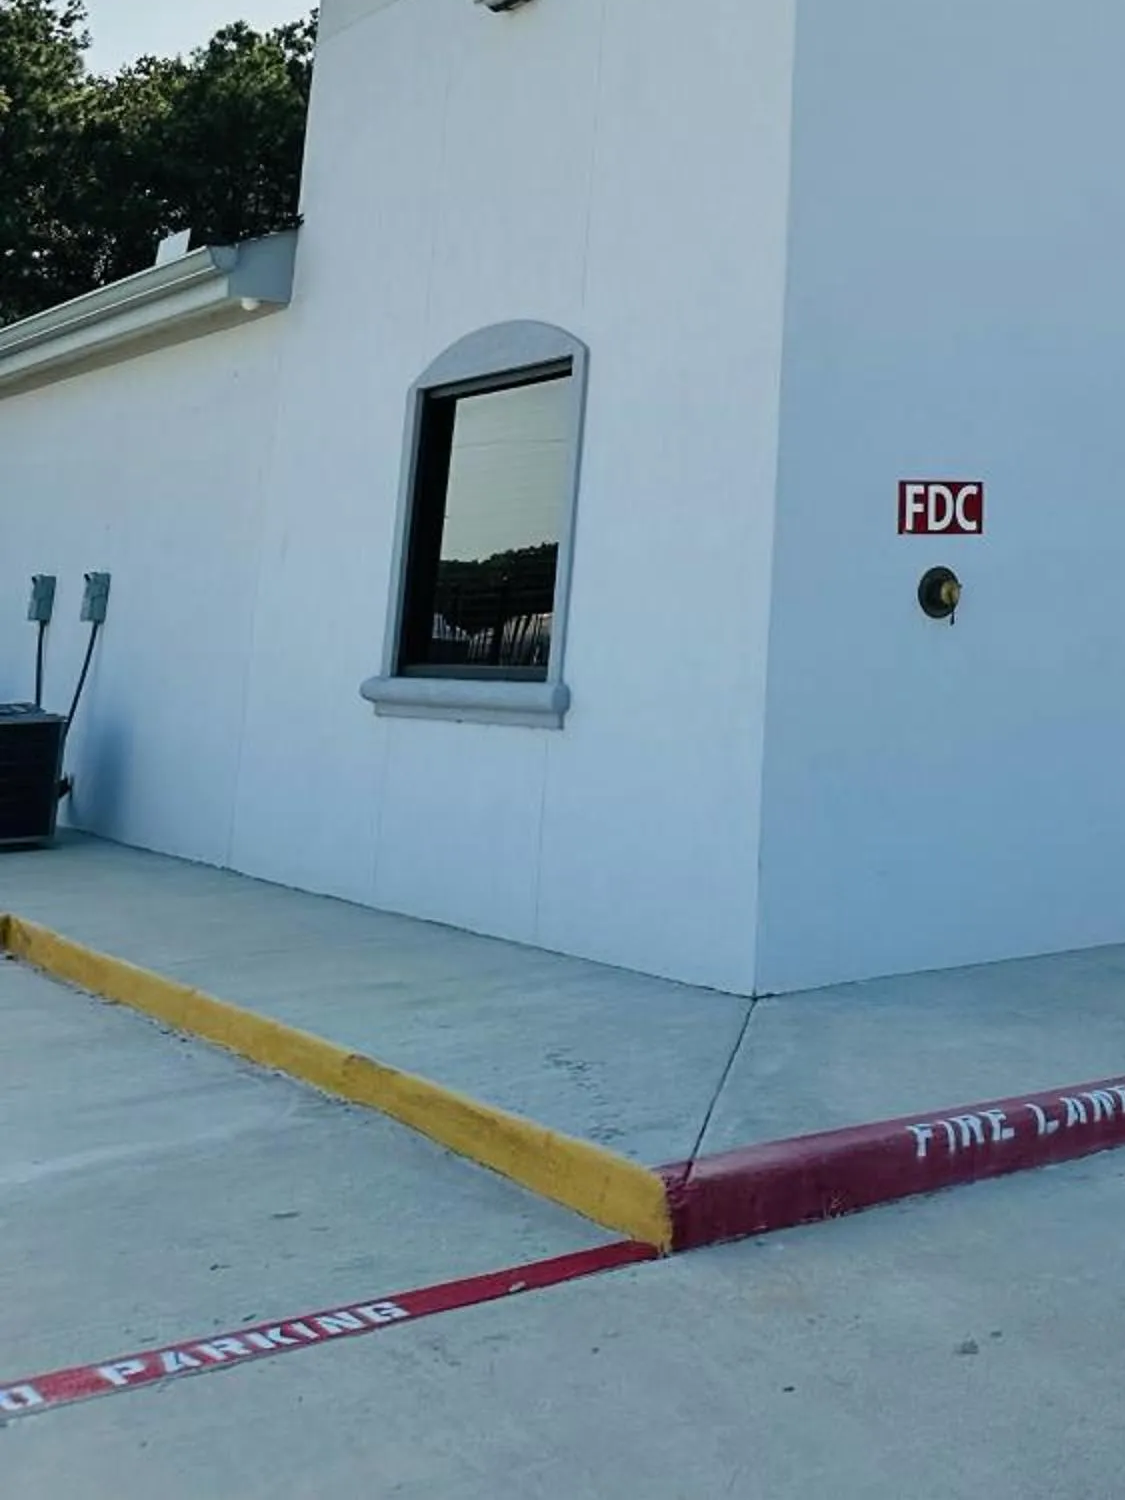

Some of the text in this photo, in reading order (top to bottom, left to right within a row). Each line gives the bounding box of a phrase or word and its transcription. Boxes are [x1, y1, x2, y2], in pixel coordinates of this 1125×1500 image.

[905, 484, 978, 531] FDC
[905, 1109, 1015, 1158] FIRE
[95, 1301, 411, 1386] PARKING
